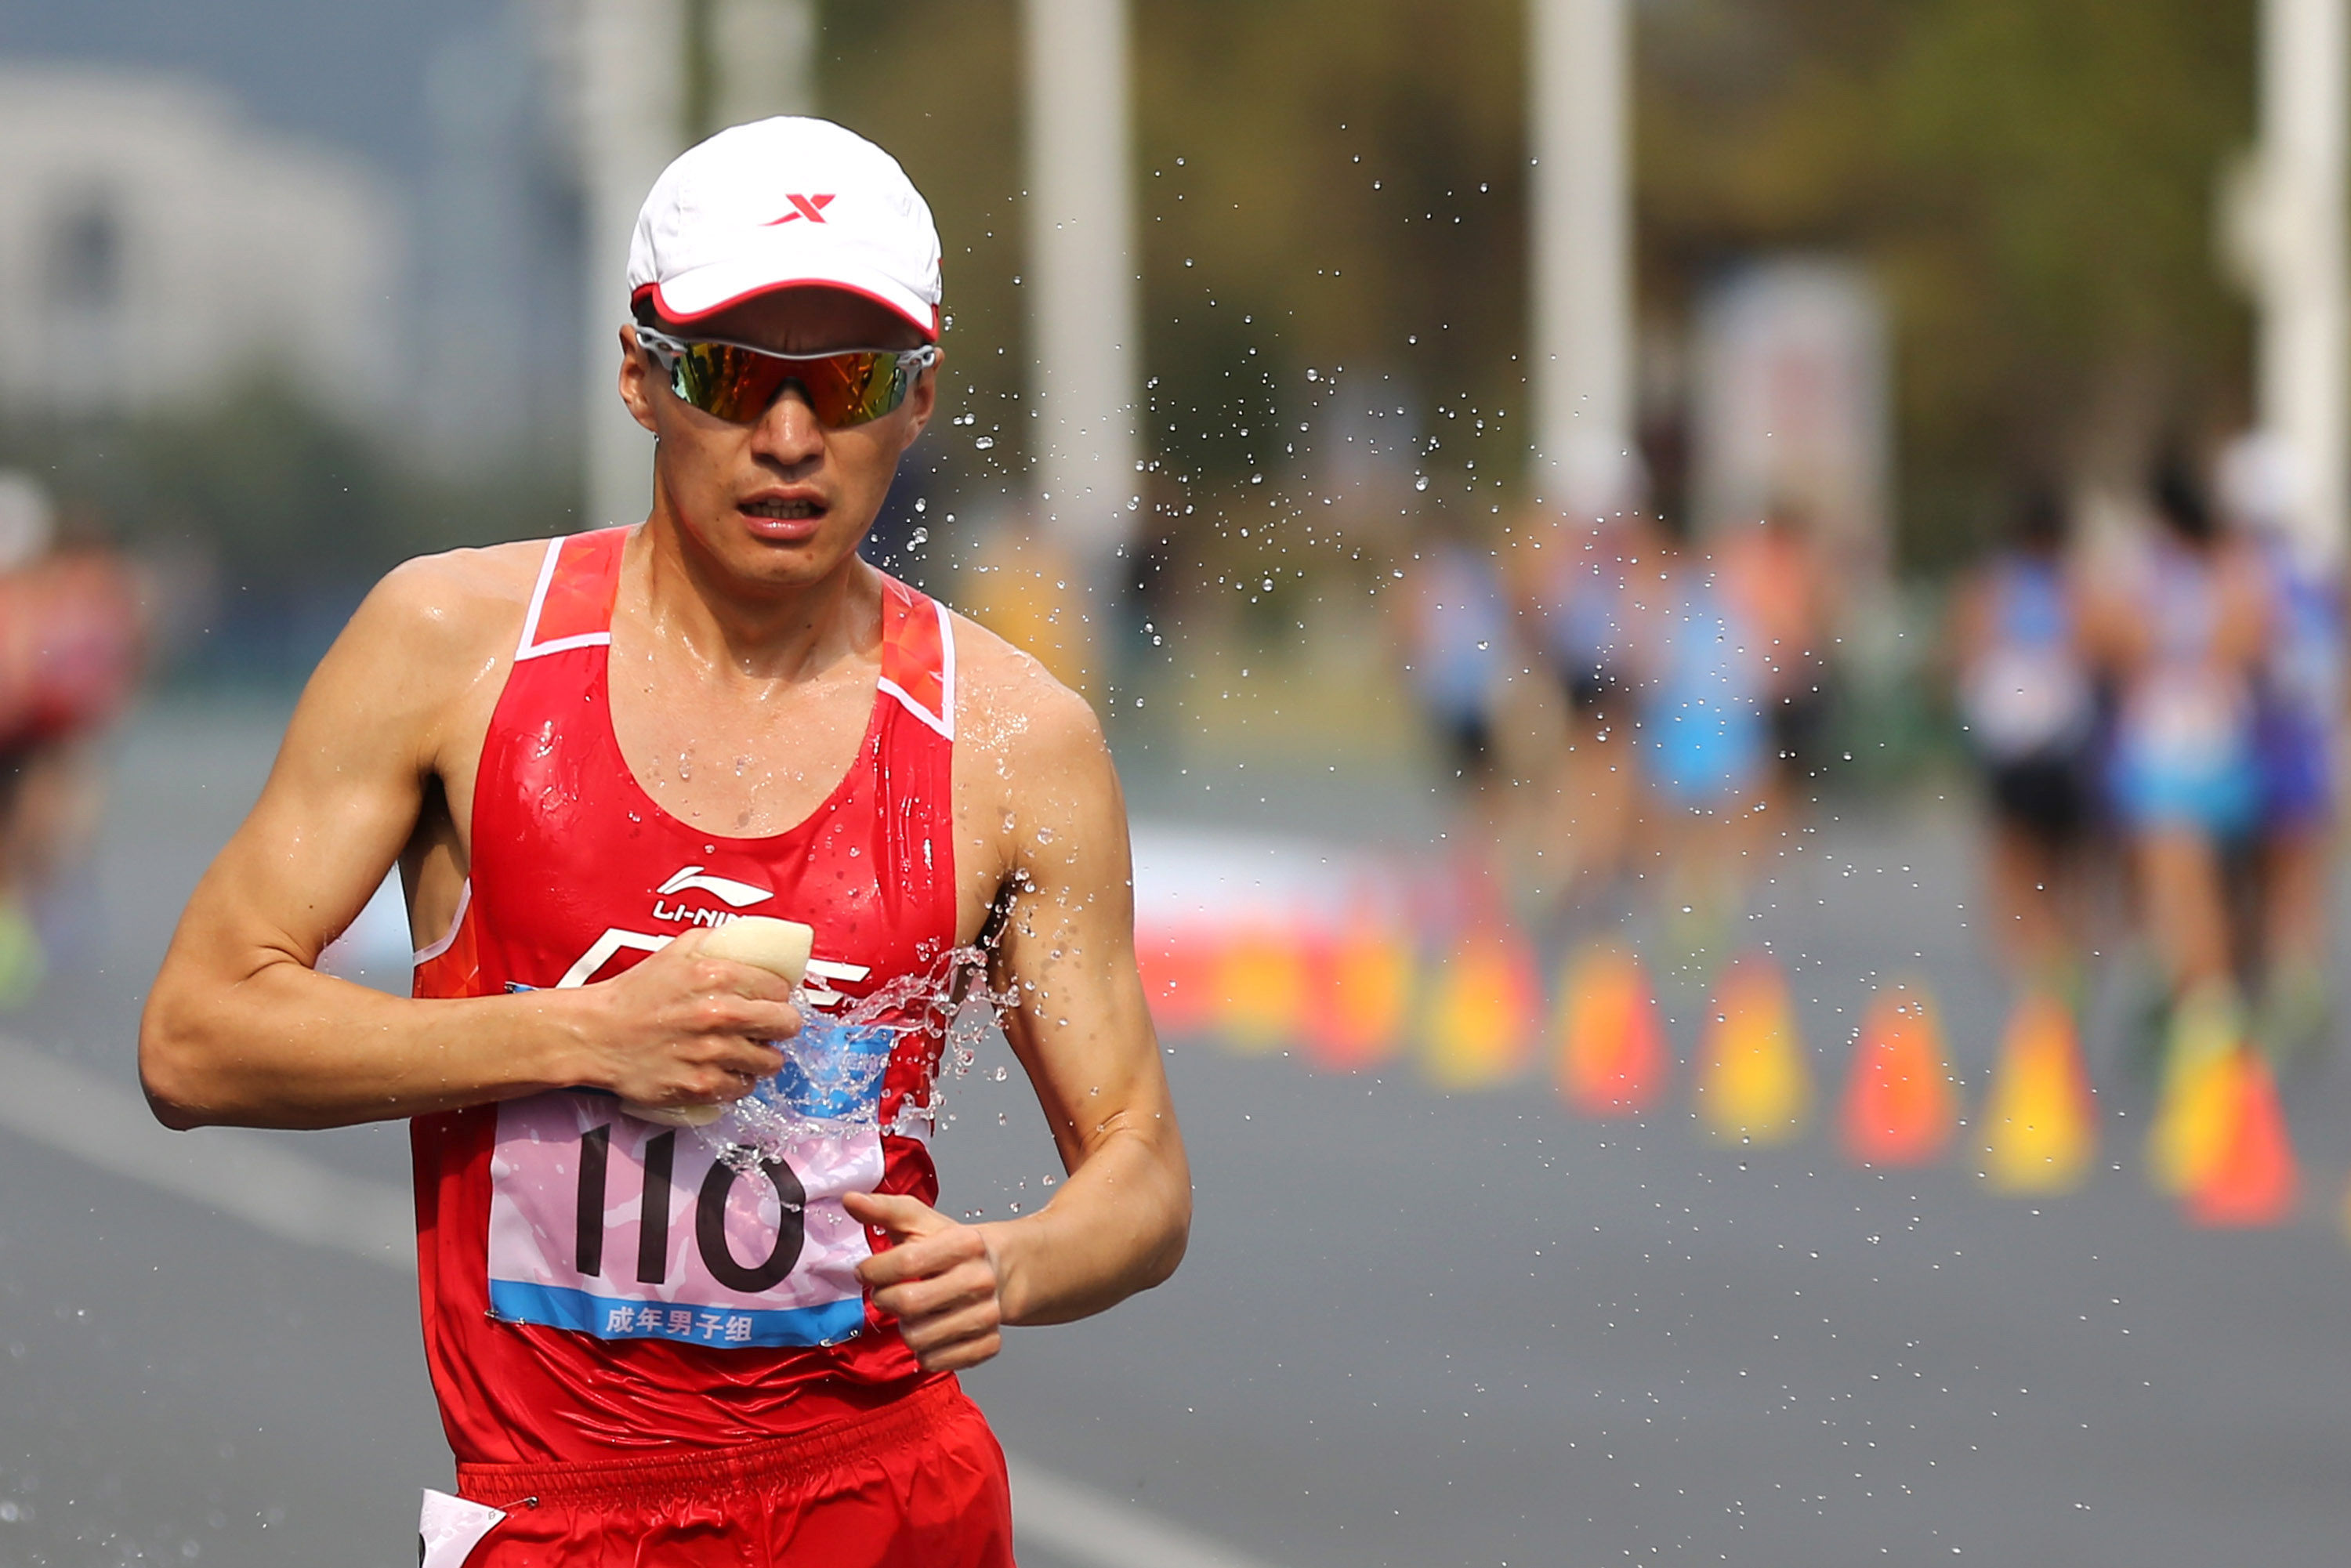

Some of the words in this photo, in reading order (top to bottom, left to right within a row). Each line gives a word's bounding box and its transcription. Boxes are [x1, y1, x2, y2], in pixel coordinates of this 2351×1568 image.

[575, 1123, 806, 1293] 110
[606, 1305, 753, 1342] 成年男子组
